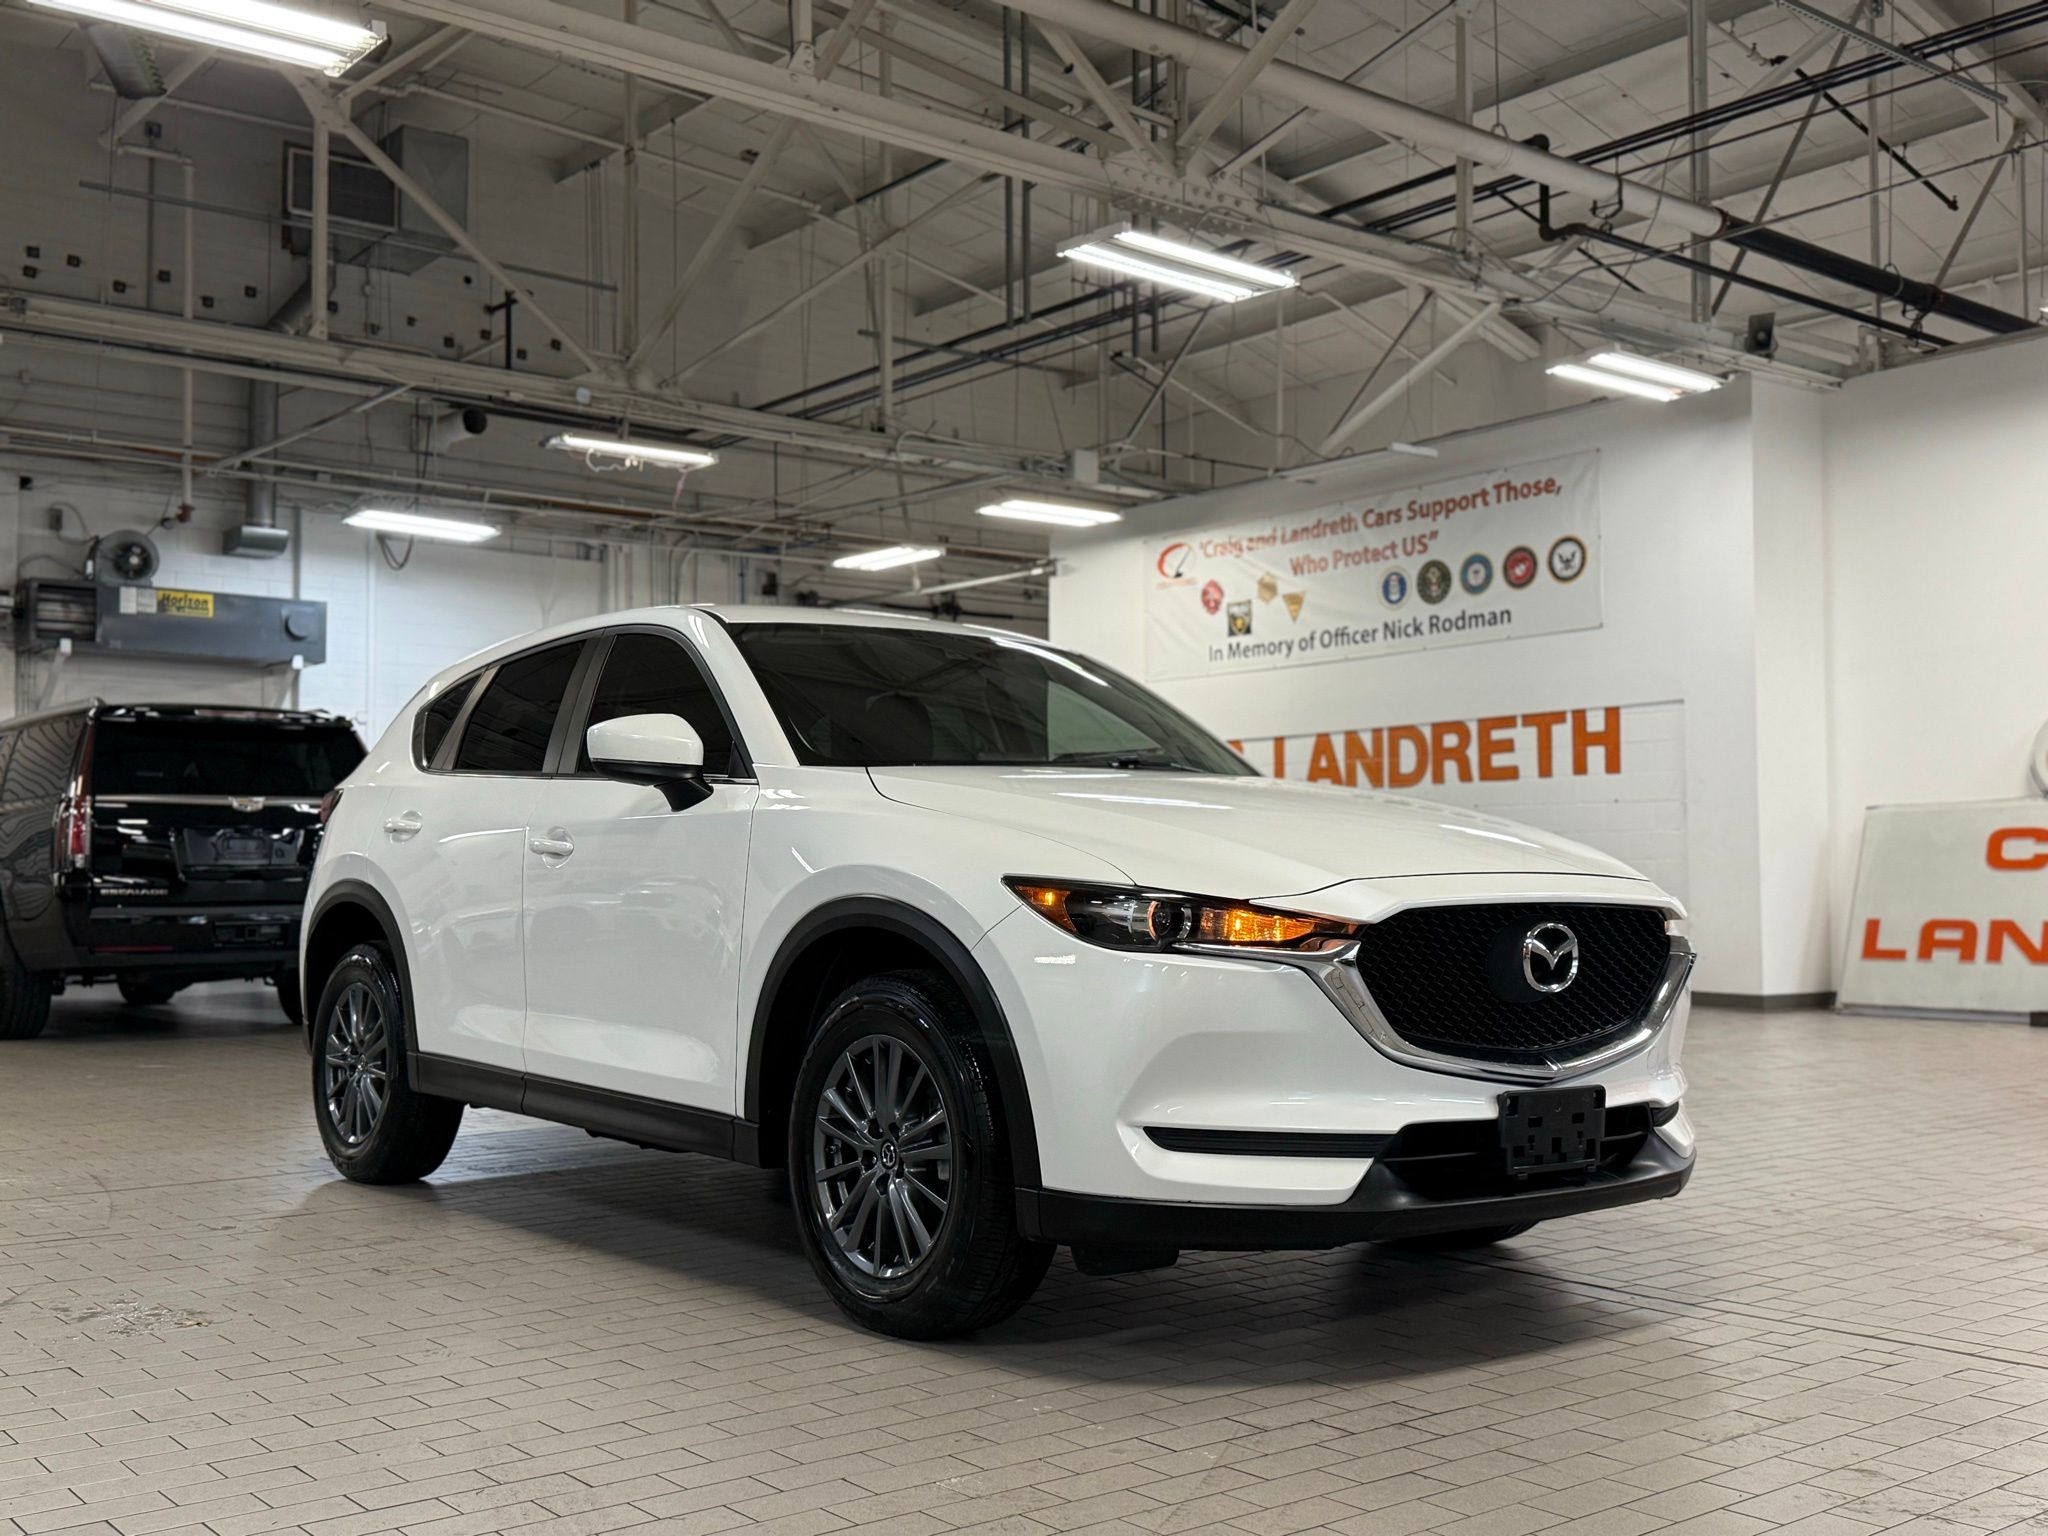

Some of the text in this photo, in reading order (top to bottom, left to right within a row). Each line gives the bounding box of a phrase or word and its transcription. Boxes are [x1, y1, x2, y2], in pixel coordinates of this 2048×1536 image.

[1281, 513, 1358, 544] Landreth
[1363, 508, 1402, 529] Cars
[1407, 488, 1489, 521] Support
[1493, 476, 1562, 504] Those,
[1290, 554, 1328, 577] Who
[1332, 541, 1398, 570] Protect
[1209, 608, 1512, 662] In Memory of Officer Nick Rodman
